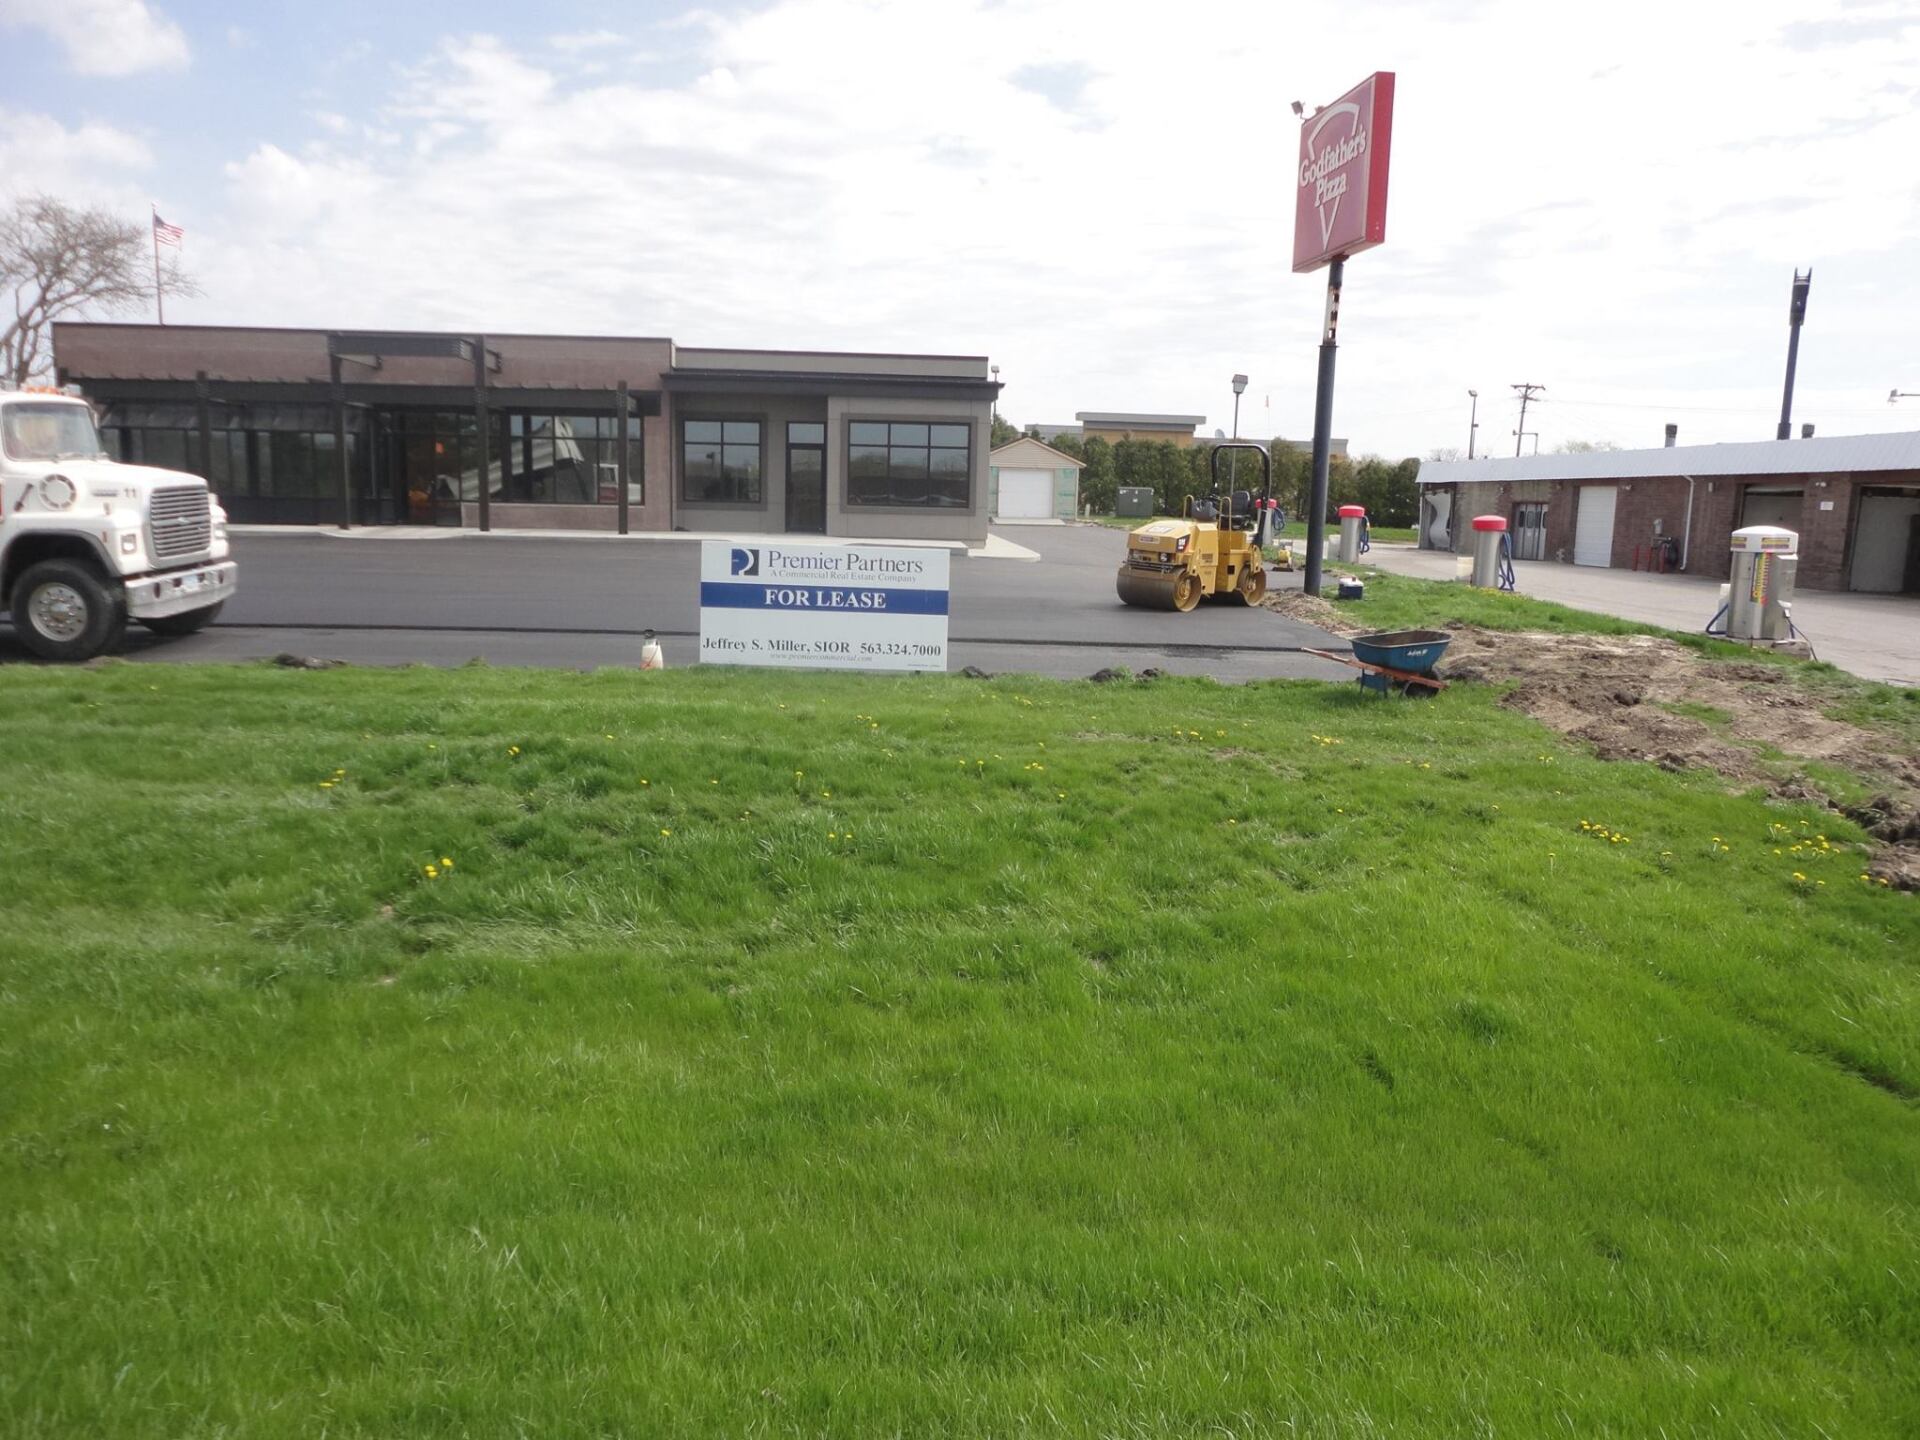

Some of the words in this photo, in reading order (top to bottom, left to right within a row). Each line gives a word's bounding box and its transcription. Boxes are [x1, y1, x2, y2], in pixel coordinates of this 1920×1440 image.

[1300, 125, 1366, 187] Godfather's
[1314, 172, 1347, 208] Pizza
[767, 550, 842, 571] Premier
[846, 553, 923, 573] Partners
[779, 570, 829, 579] Commercial
[831, 571, 849, 580] Real
[850, 572, 875, 581] Estate
[878, 573, 917, 583] Company
[764, 589, 810, 606] FOR
[815, 591, 887, 609] LEASE
[702, 637, 746, 652] Jeffrey
[751, 638, 763, 650] S.
[767, 639, 811, 653] Miller,
[814, 640, 850, 653] SIOR
[860, 642, 941, 657] 563.324.7000
